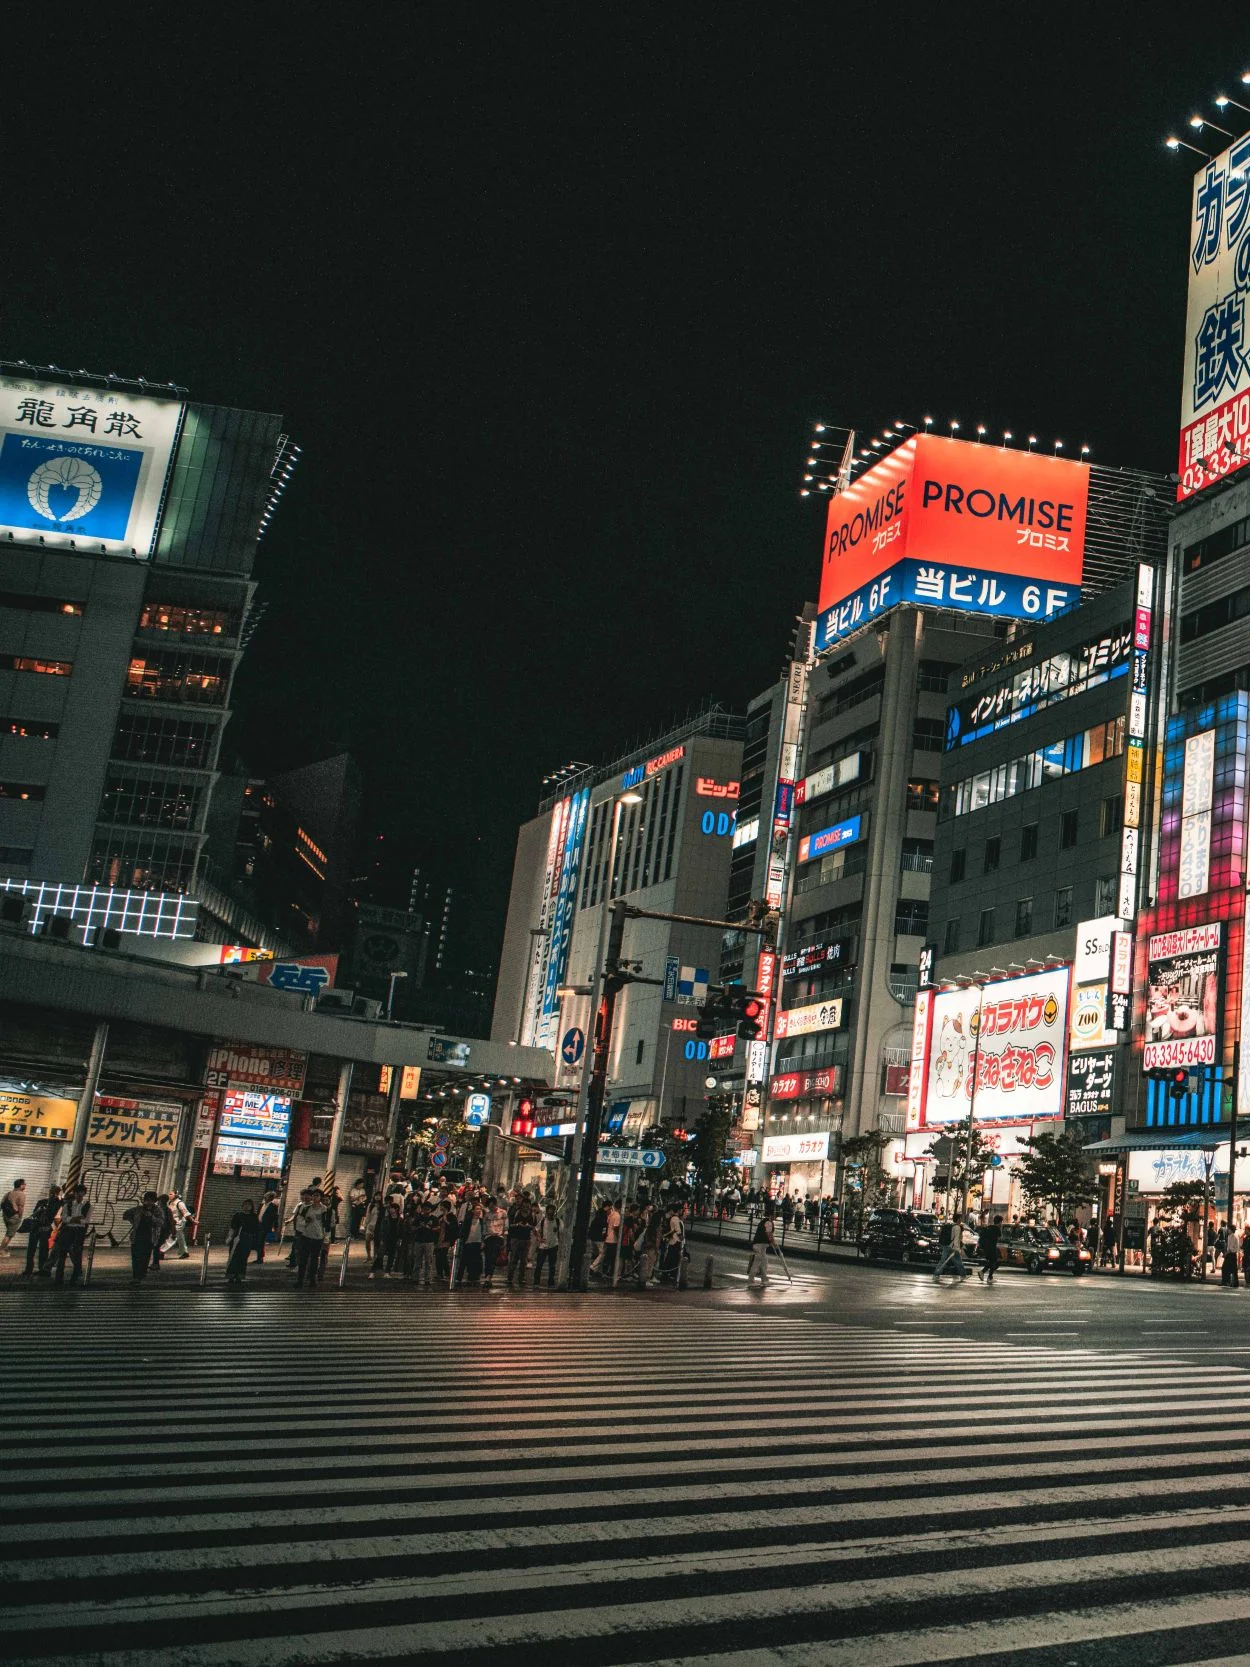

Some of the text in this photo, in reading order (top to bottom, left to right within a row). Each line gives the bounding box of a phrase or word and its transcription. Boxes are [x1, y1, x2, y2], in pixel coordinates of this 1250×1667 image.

[15, 398, 144, 439] 龍角散
[922, 480, 1074, 532] PROMISE
[828, 479, 906, 563] PROMISE
[872, 520, 901, 555] プロミス
[1016, 529, 1070, 552] プロミス
[915, 567, 1068, 616] 当ビル 6F
[826, 575, 892, 641] 当ビル 6F
[658, 746, 684, 769] CAMERA
[696, 777, 740, 799] ビック
[1180, 737, 1200, 898] 03-3345-6430
[815, 828, 842, 850] PROMISE
[1085, 939, 1098, 955] SS
[1118, 936, 1129, 988] カラオケ
[759, 955, 774, 999] カラオケ
[673, 1018, 698, 1031] BIC
[980, 992, 1047, 1038] カラオケ
[1078, 1011, 1098, 1027] ZOO
[209, 1048, 270, 1076] iPhone
[964, 1043, 1057, 1102] まねきねこ
[1071, 1054, 1113, 1075] ビリヤード
[206, 1071, 228, 1087] 2F
[404, 1066, 415, 1089] 門店
[772, 1075, 797, 1094] カラオケ
[1086, 1072, 1112, 1090] ダーツ
[1070, 1100, 1098, 1113] BAGUS
[90, 1116, 175, 1147] チケット オズ
[645, 1155, 652, 1163] 4
[799, 1140, 824, 1155] カラオケ
[1114, 1167, 1123, 1215] BAGUS
